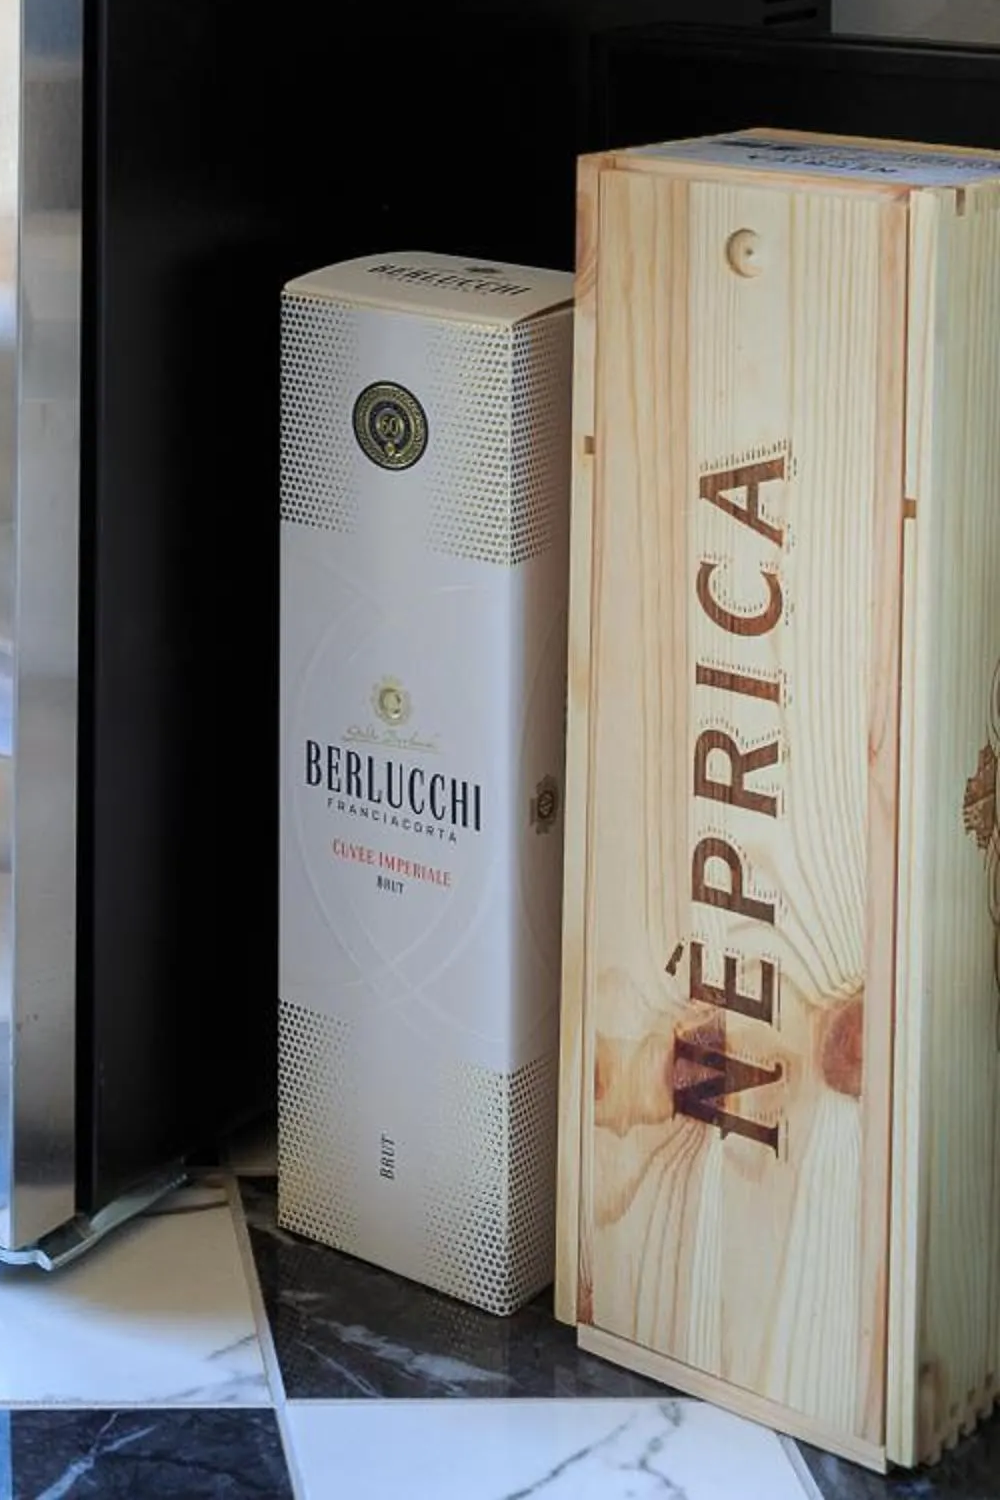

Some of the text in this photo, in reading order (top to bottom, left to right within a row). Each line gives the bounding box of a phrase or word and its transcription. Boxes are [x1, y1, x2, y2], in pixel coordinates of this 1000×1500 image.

[305, 739, 482, 832] BERLUCCHI
[327, 797, 457, 843] FRANCIACORTA
[376, 875, 404, 894] BRUT
[379, 851, 452, 887] IMPERIALE
[380, 1133, 395, 1180] BRUT
